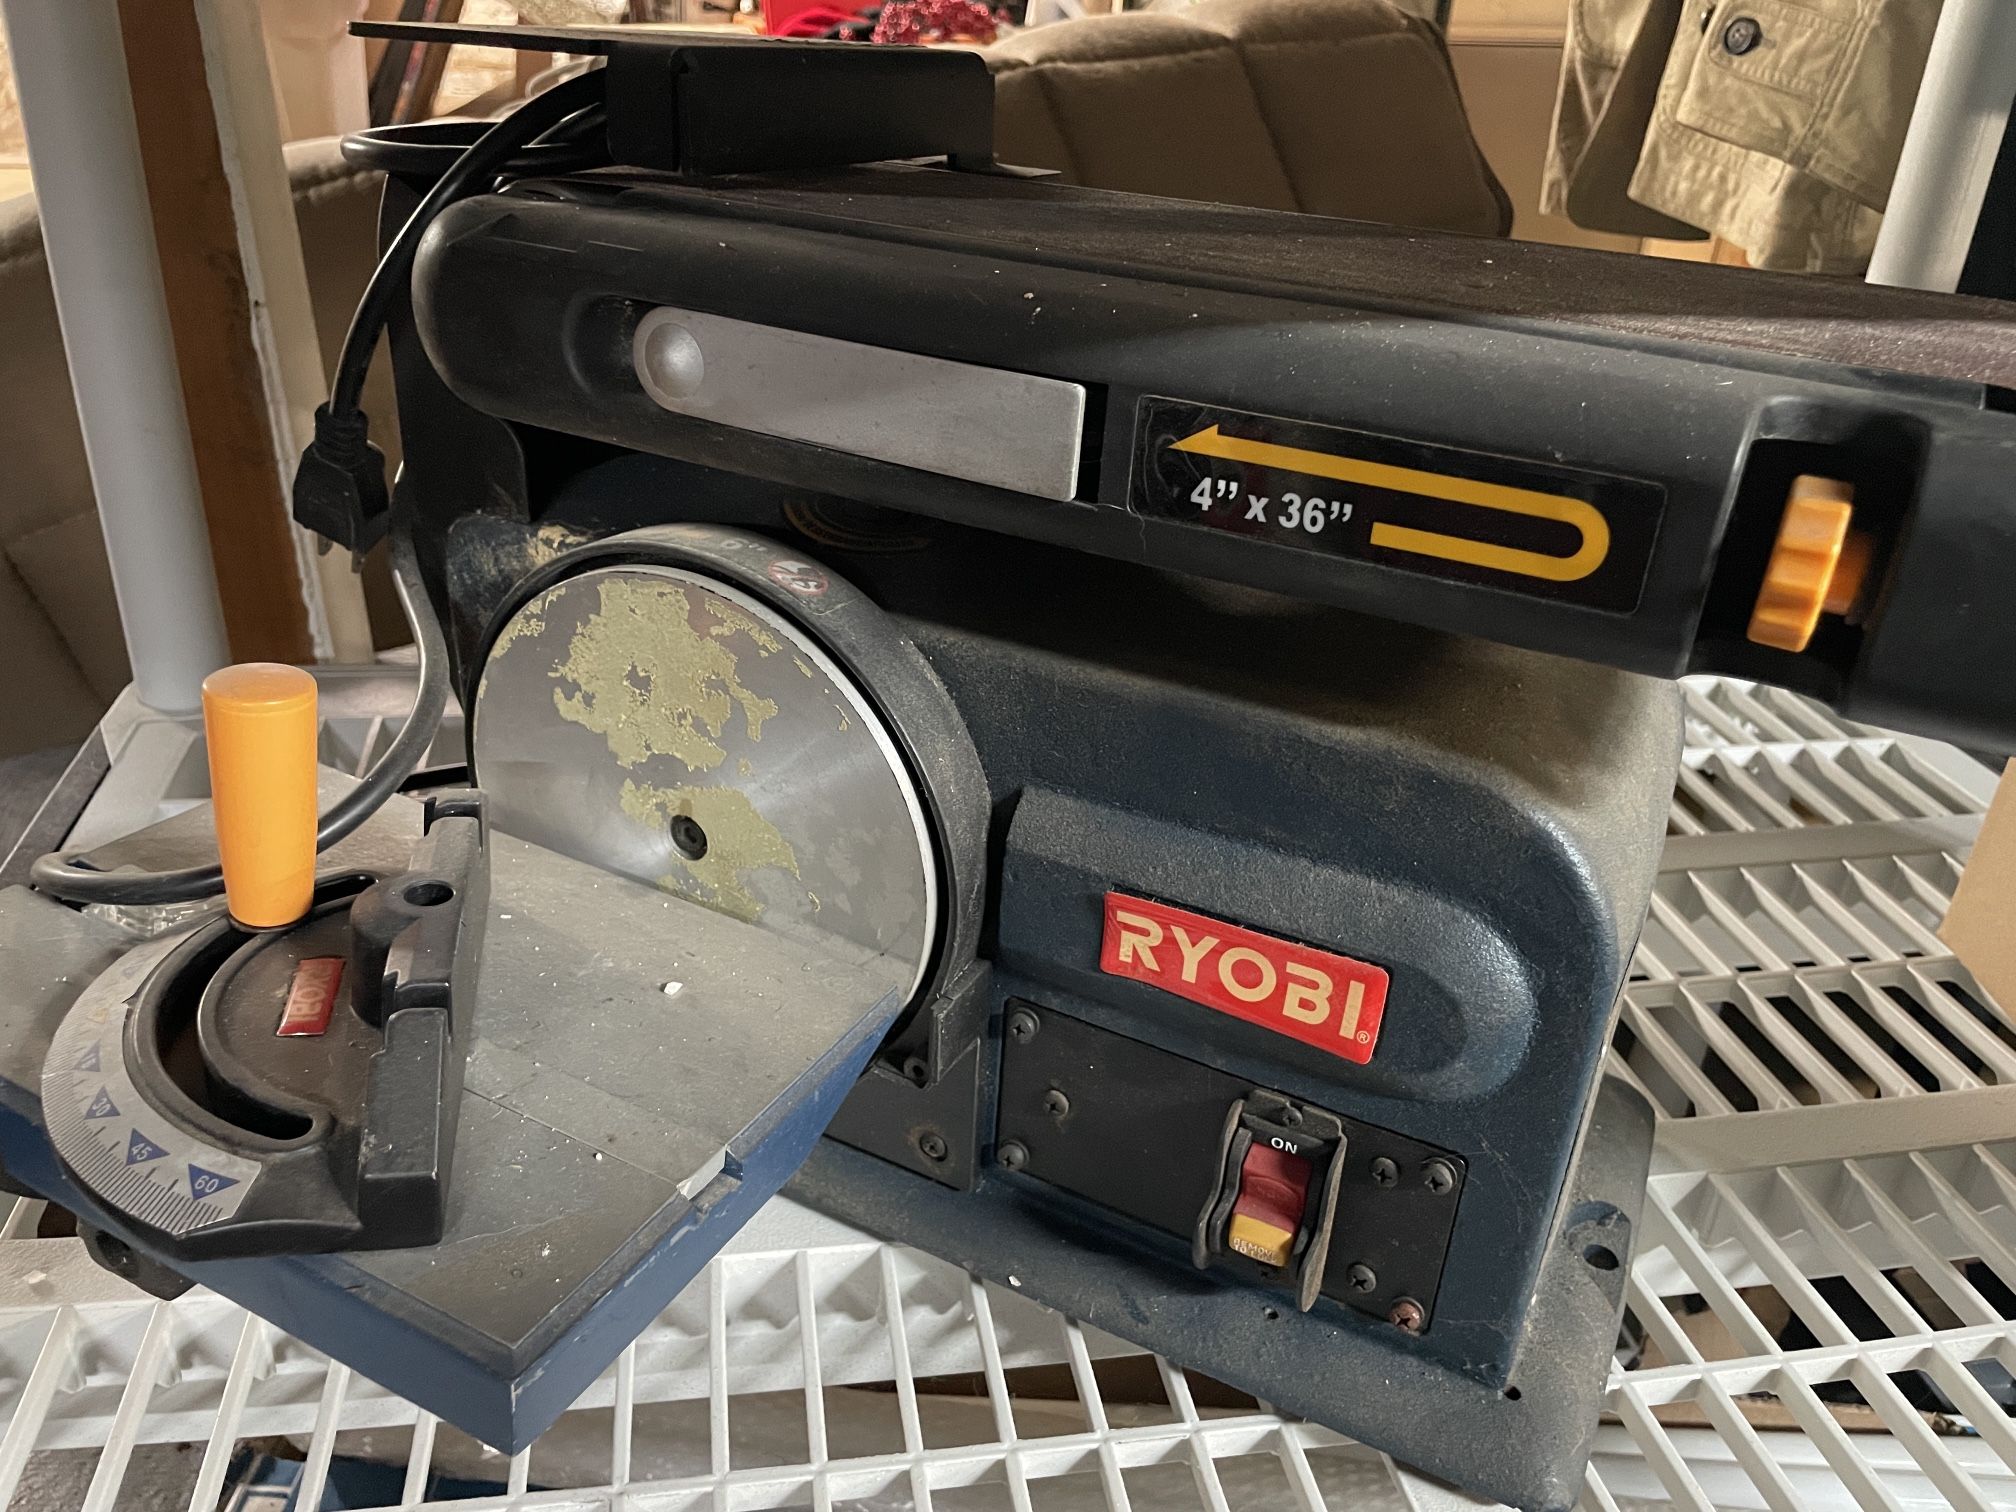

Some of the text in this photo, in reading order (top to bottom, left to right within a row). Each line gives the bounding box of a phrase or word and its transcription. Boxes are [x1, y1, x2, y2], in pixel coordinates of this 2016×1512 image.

[1244, 494, 1270, 523] x
[92, 1097, 111, 1116] 30
[132, 1142, 153, 1161] 45
[1271, 1137, 1297, 1154] ON
[194, 1175, 219, 1193] 60
[1233, 1237, 1276, 1257] REMOV
